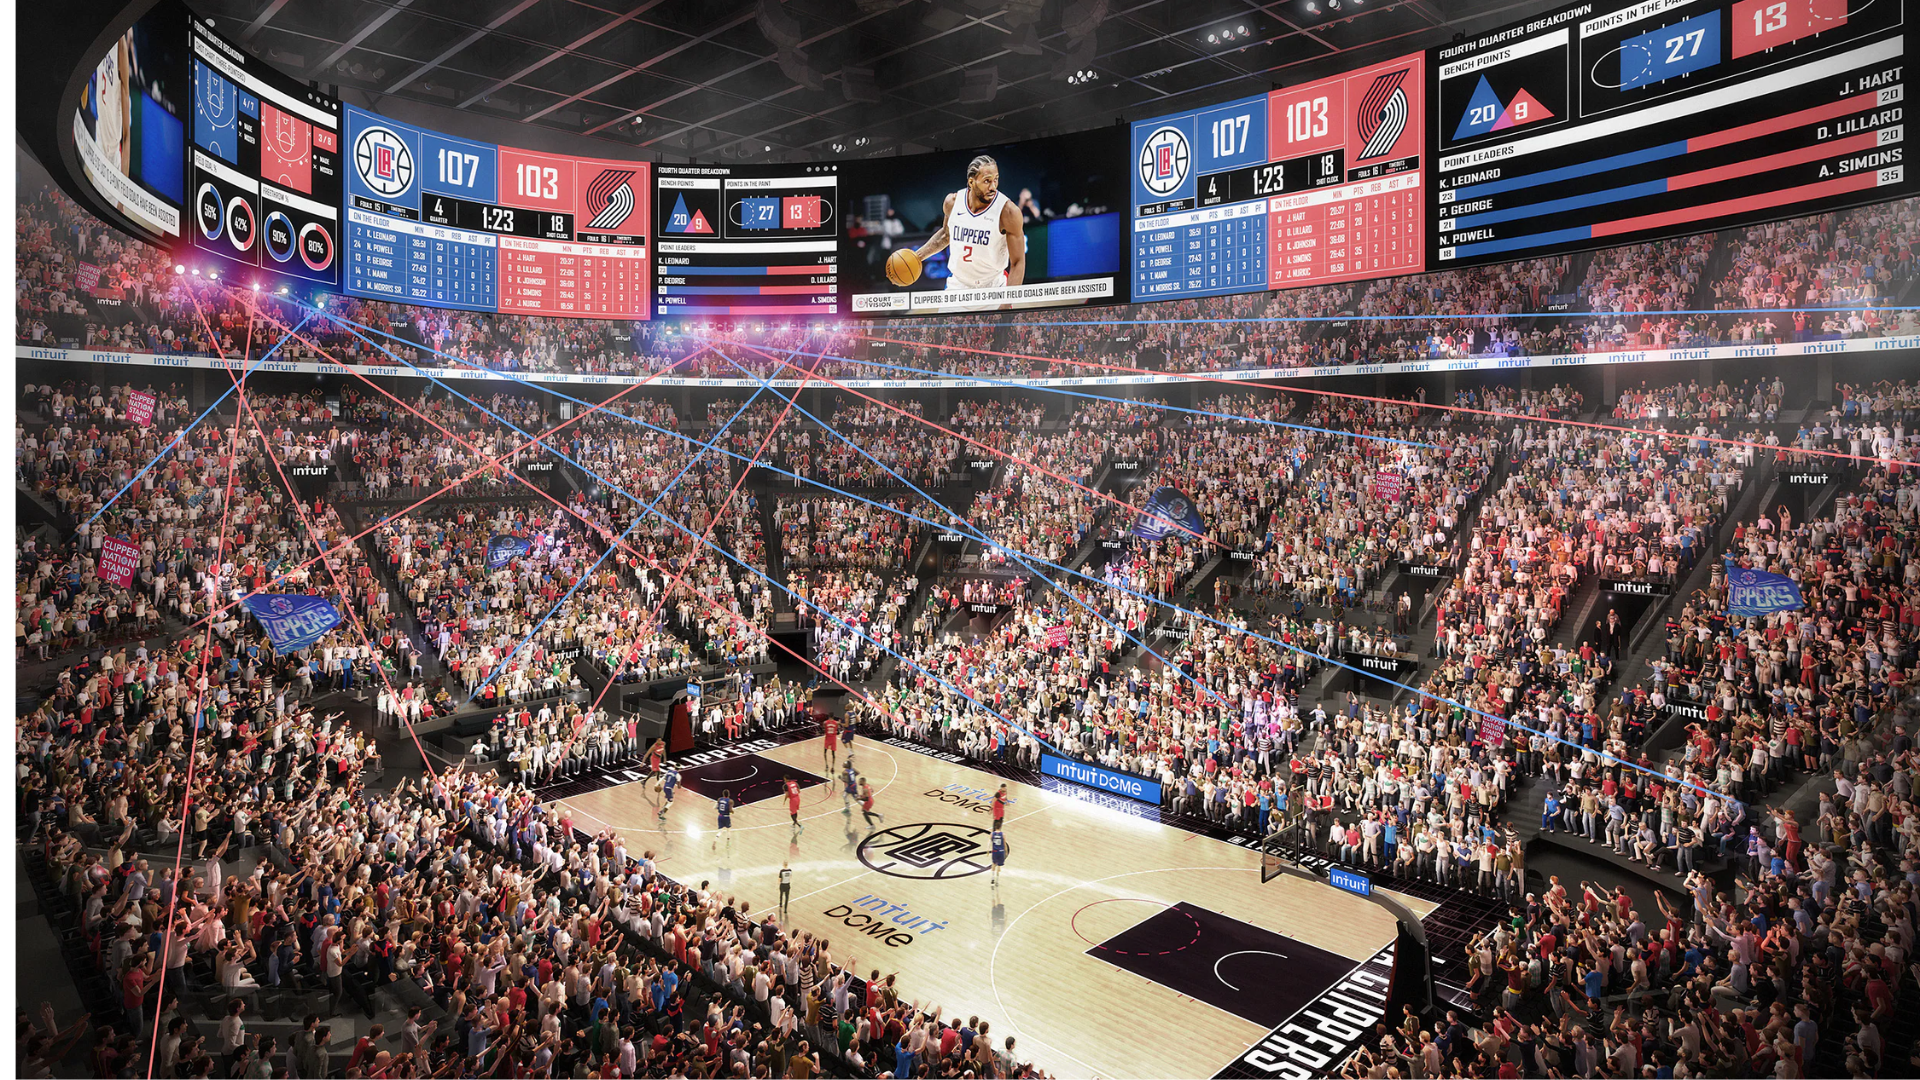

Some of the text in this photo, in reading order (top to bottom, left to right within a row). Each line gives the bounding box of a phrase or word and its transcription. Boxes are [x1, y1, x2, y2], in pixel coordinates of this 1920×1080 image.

[1586, 14, 1623, 34] POINTS
[1626, 8, 1638, 20] IN
[1641, 1, 1661, 14] THE
[1753, 2, 1787, 36] 13
[1439, 4, 1592, 60] FOURTH QUARTER BREAKDOWN
[1666, 28, 1705, 64] 27
[1444, 50, 1511, 76] BENCH POINTS
[1839, 66, 1903, 96] J. HART
[1881, 88, 1899, 102] 20
[1286, 96, 1328, 144] 103
[1470, 104, 1496, 126] 20
[1514, 102, 1528, 120] 9
[1817, 108, 1903, 140] D. LILLARD
[1212, 114, 1250, 158] 107
[1881, 130, 1899, 142] 20
[1321, 154, 1334, 176] 18
[1444, 146, 1514, 168] POINT LEADERS
[1818, 148, 1903, 178] A. SIMONS
[438, 148, 480, 188] 107
[1358, 166, 1378, 178] FOULS 16
[1882, 170, 1899, 182] 35
[516, 163, 558, 200] 103
[1208, 177, 1216, 195] 4
[1253, 165, 1284, 195] 1:23
[1316, 175, 1338, 185] SHOT CLOCK
[1332, 176, 1414, 199] MIN PTS REB AST PF
[1439, 168, 1500, 190] K. LEONARD
[1275, 196, 1308, 209] ON THE FLOOR
[1442, 192, 1453, 200] 23
[434, 198, 444, 215] 4
[758, 206, 774, 220] 27
[790, 205, 802, 219] 13
[1439, 199, 1493, 218] P. GEORGE
[234, 216, 248, 232] 42%
[430, 216, 448, 224] QUARTER
[482, 206, 514, 232] 1:23
[551, 215, 563, 232] 18
[674, 214, 687, 225] 20
[695, 218, 702, 230] 9
[1443, 222, 1451, 230] 21
[272, 230, 286, 244] 90%
[953, 226, 990, 246] CLIPPERS
[1439, 228, 1495, 246] N. POWELL
[308, 240, 324, 254] 80%
[963, 246, 973, 262] 2
[914, 295, 943, 304] CLIPPERS:
[944, 295, 948, 303] 9
[958, 293, 973, 302] LAST
[974, 293, 980, 301] 10
[981, 291, 1005, 300] 3-POINT
[1007, 290, 1022, 299] FIELD
[1024, 288, 1043, 298] GOALS
[1044, 287, 1059, 296] HAVE
[1060, 285, 1076, 294] BEEN
[1077, 283, 1107, 293] ASSISTED
[129, 399, 154, 412] NATION
[130, 392, 155, 405] CLIPPER
[129, 406, 149, 419] STAND
[132, 414, 143, 423] UP!
[1376, 474, 1400, 482] CLIPPER
[1376, 480, 1399, 489] NATION
[1378, 486, 1397, 495] STAND
[104, 540, 139, 558] CLIPPER
[102, 550, 135, 568] NATION
[102, 560, 130, 576] STAND
[107, 571, 120, 584] UP!
[602, 766, 648, 784] LA
[1057, 763, 1098, 783] intuit
[1332, 874, 1366, 892] intuit
[852, 895, 949, 934] intuit
